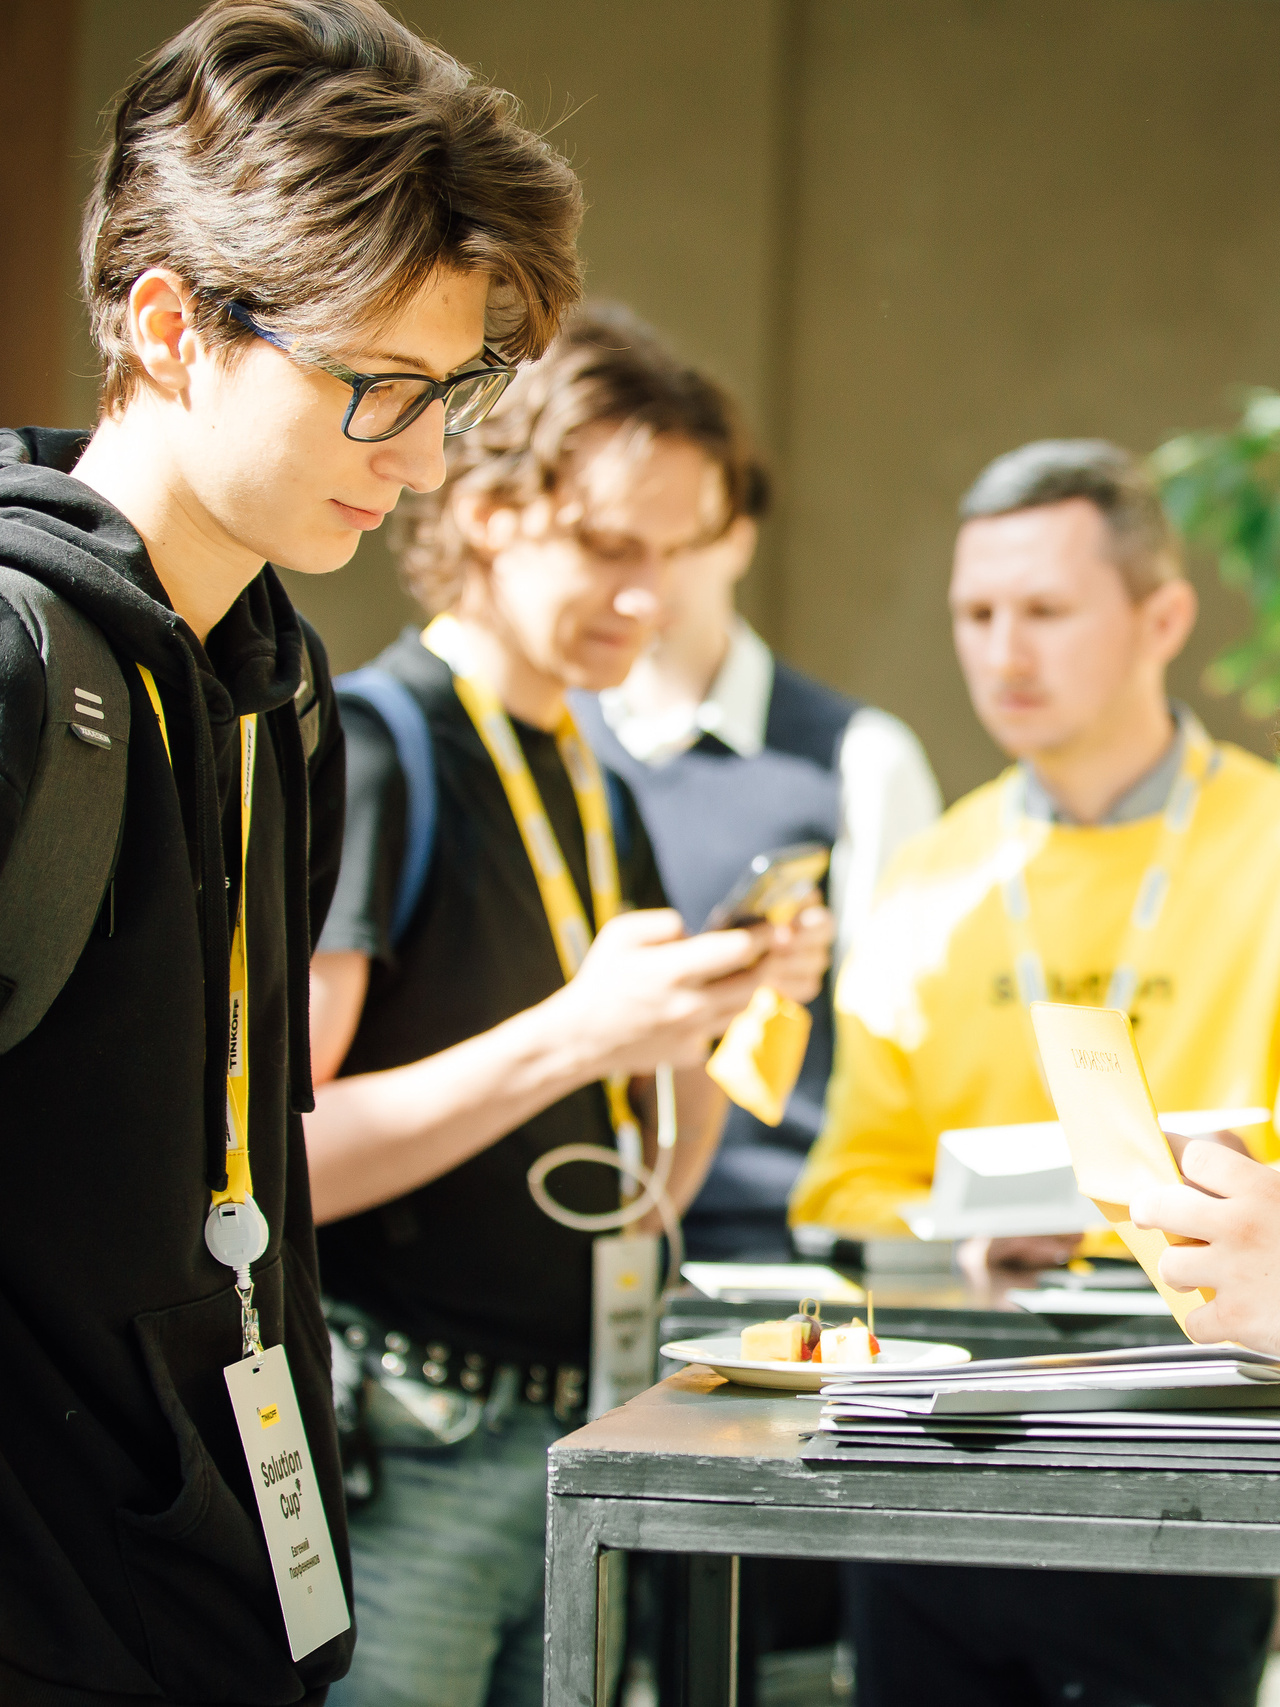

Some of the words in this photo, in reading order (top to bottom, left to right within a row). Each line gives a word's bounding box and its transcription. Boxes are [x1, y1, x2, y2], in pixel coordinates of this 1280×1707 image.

[229, 999, 239, 1070] TINKOFF
[261, 1450, 303, 1488] Solution
[280, 1492, 301, 1520] Cup
